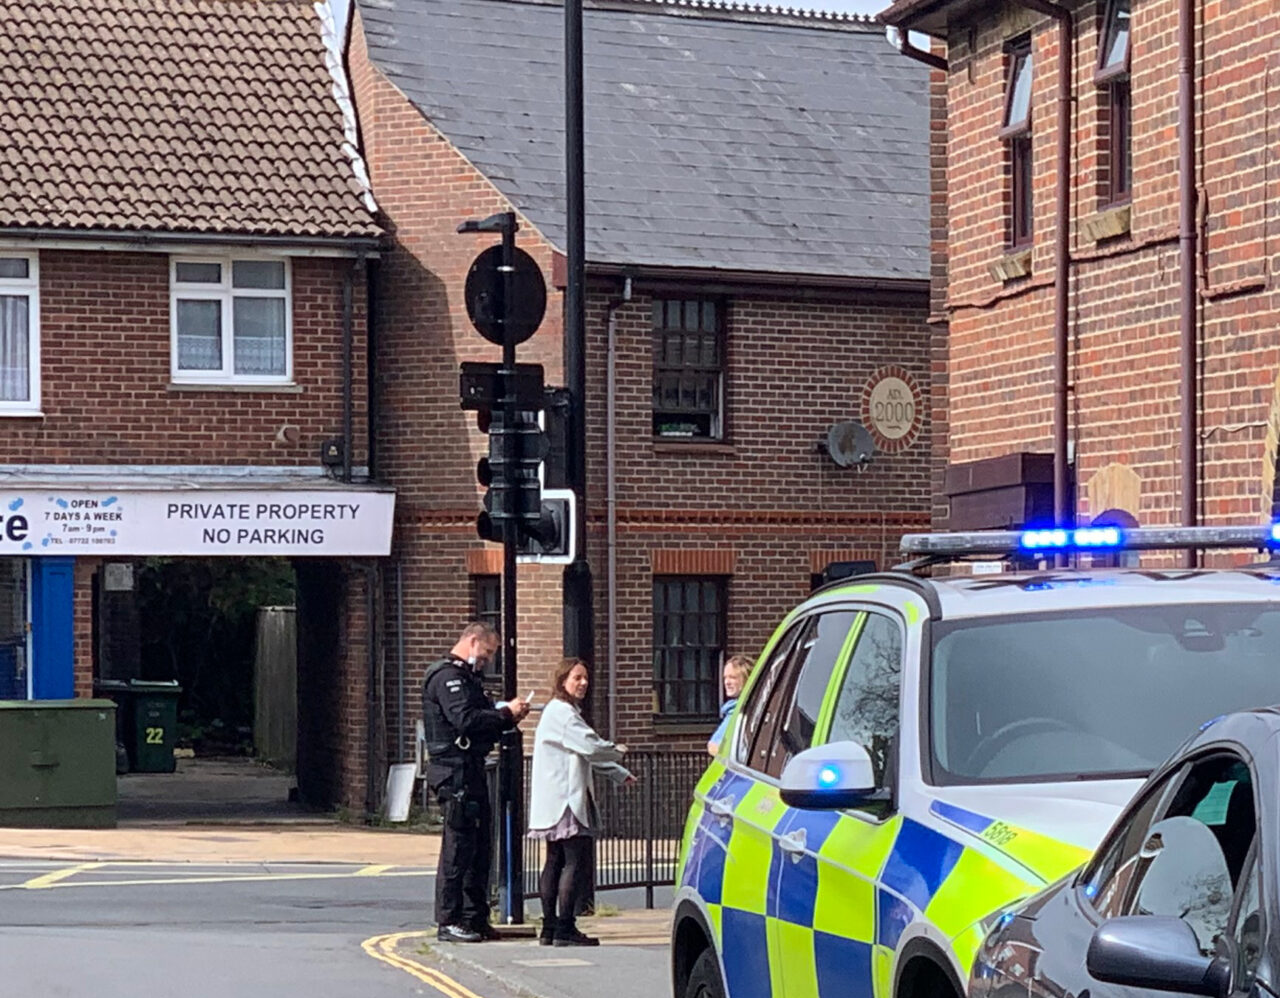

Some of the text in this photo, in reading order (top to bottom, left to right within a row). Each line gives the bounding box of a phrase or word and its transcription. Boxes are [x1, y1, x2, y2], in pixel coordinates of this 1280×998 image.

[875, 401, 914, 422] 2000
[71, 500, 98, 508] OPEN
[167, 504, 361, 520] PRIVATE PROPERTY
[45, 512, 122, 521] 7 DAYS A WEEK
[202, 528, 325, 544] NO PARKING
[146, 727, 164, 744] 22
